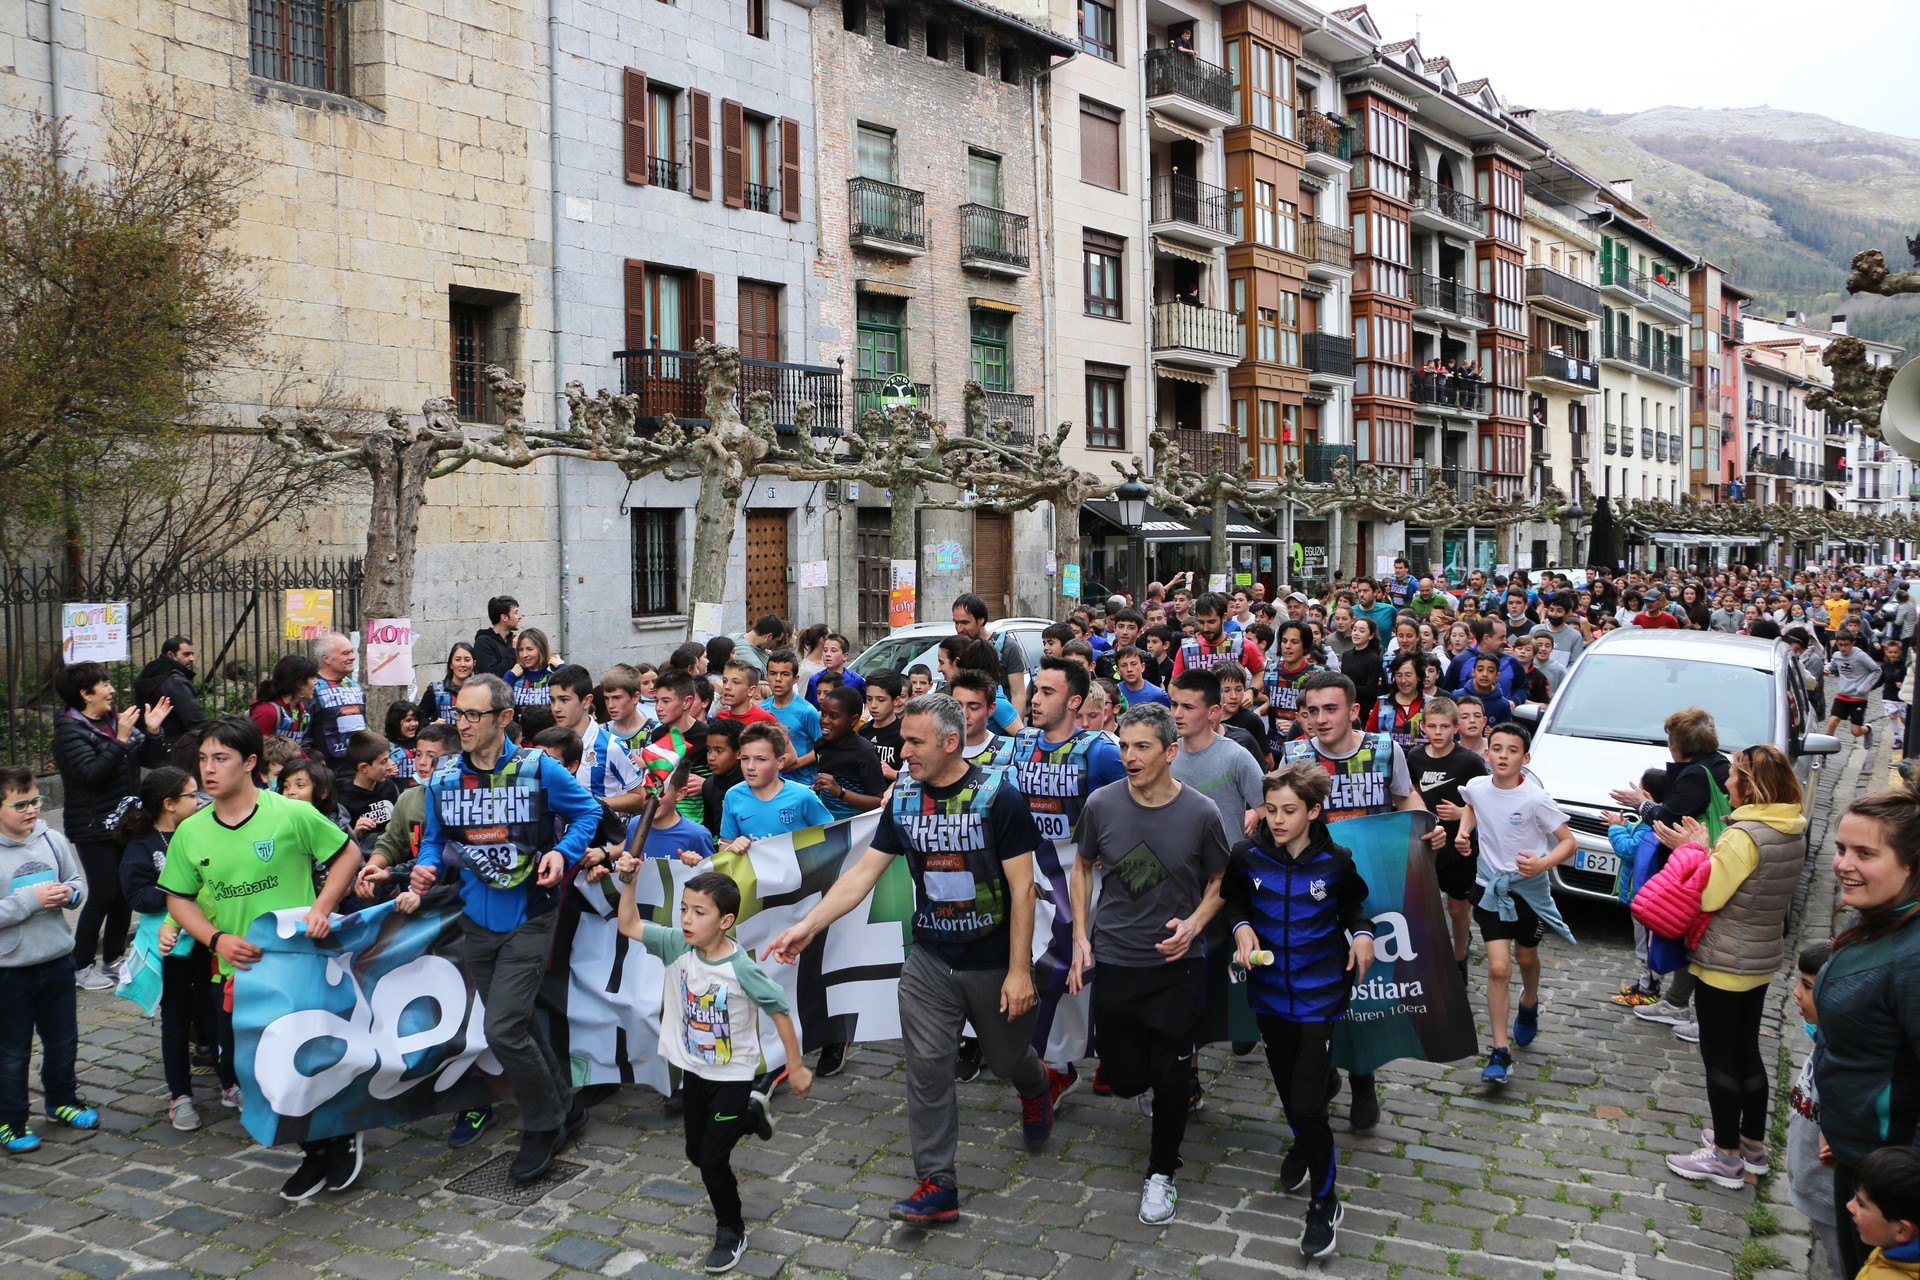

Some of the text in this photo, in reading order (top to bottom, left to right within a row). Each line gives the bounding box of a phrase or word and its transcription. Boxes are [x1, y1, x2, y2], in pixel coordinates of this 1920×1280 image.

[1305, 547, 1325, 557] EGUZKI
[63, 603, 127, 628] korrika
[1421, 771, 1447, 783] NIKE
[369, 801, 385, 811] THE
[935, 906, 955, 917] aek
[1388, 1003, 1428, 1016] 10era
